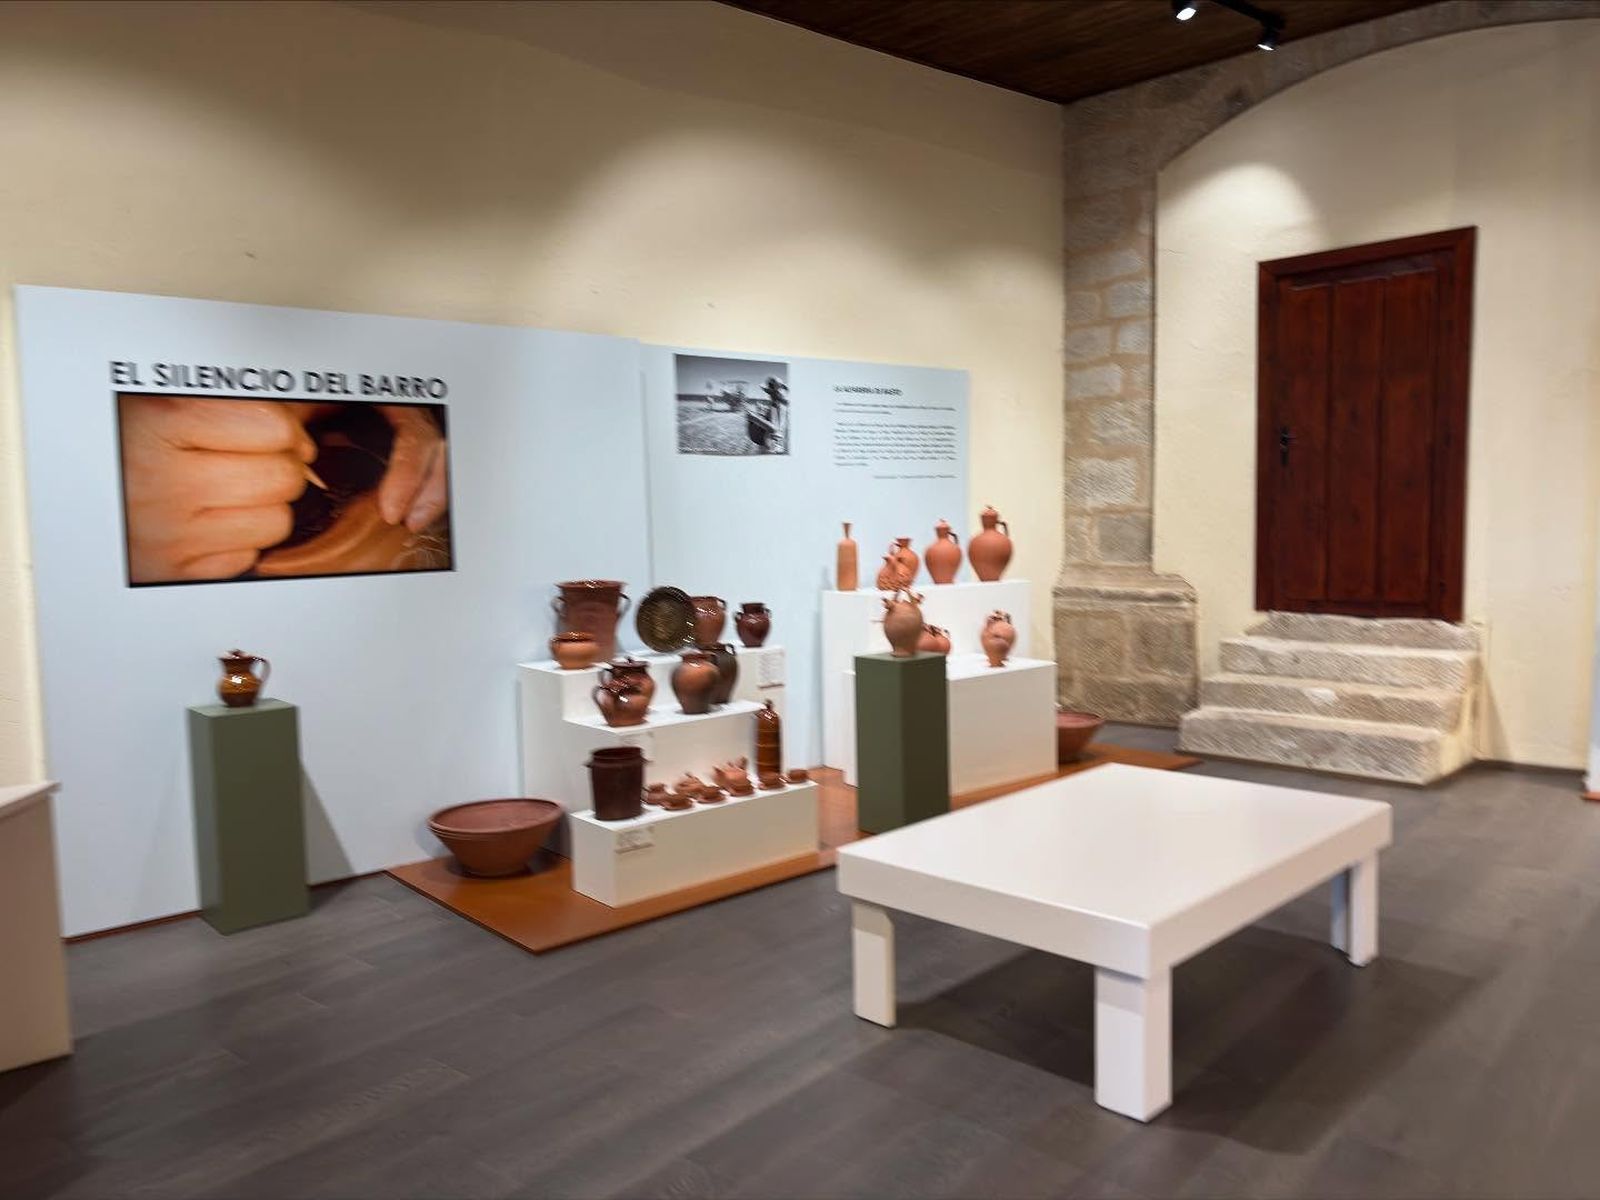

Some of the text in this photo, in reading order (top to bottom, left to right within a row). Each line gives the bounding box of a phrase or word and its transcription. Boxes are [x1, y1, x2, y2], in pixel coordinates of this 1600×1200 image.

[110, 361, 448, 399] EL SILENCIO DEL BARRO
